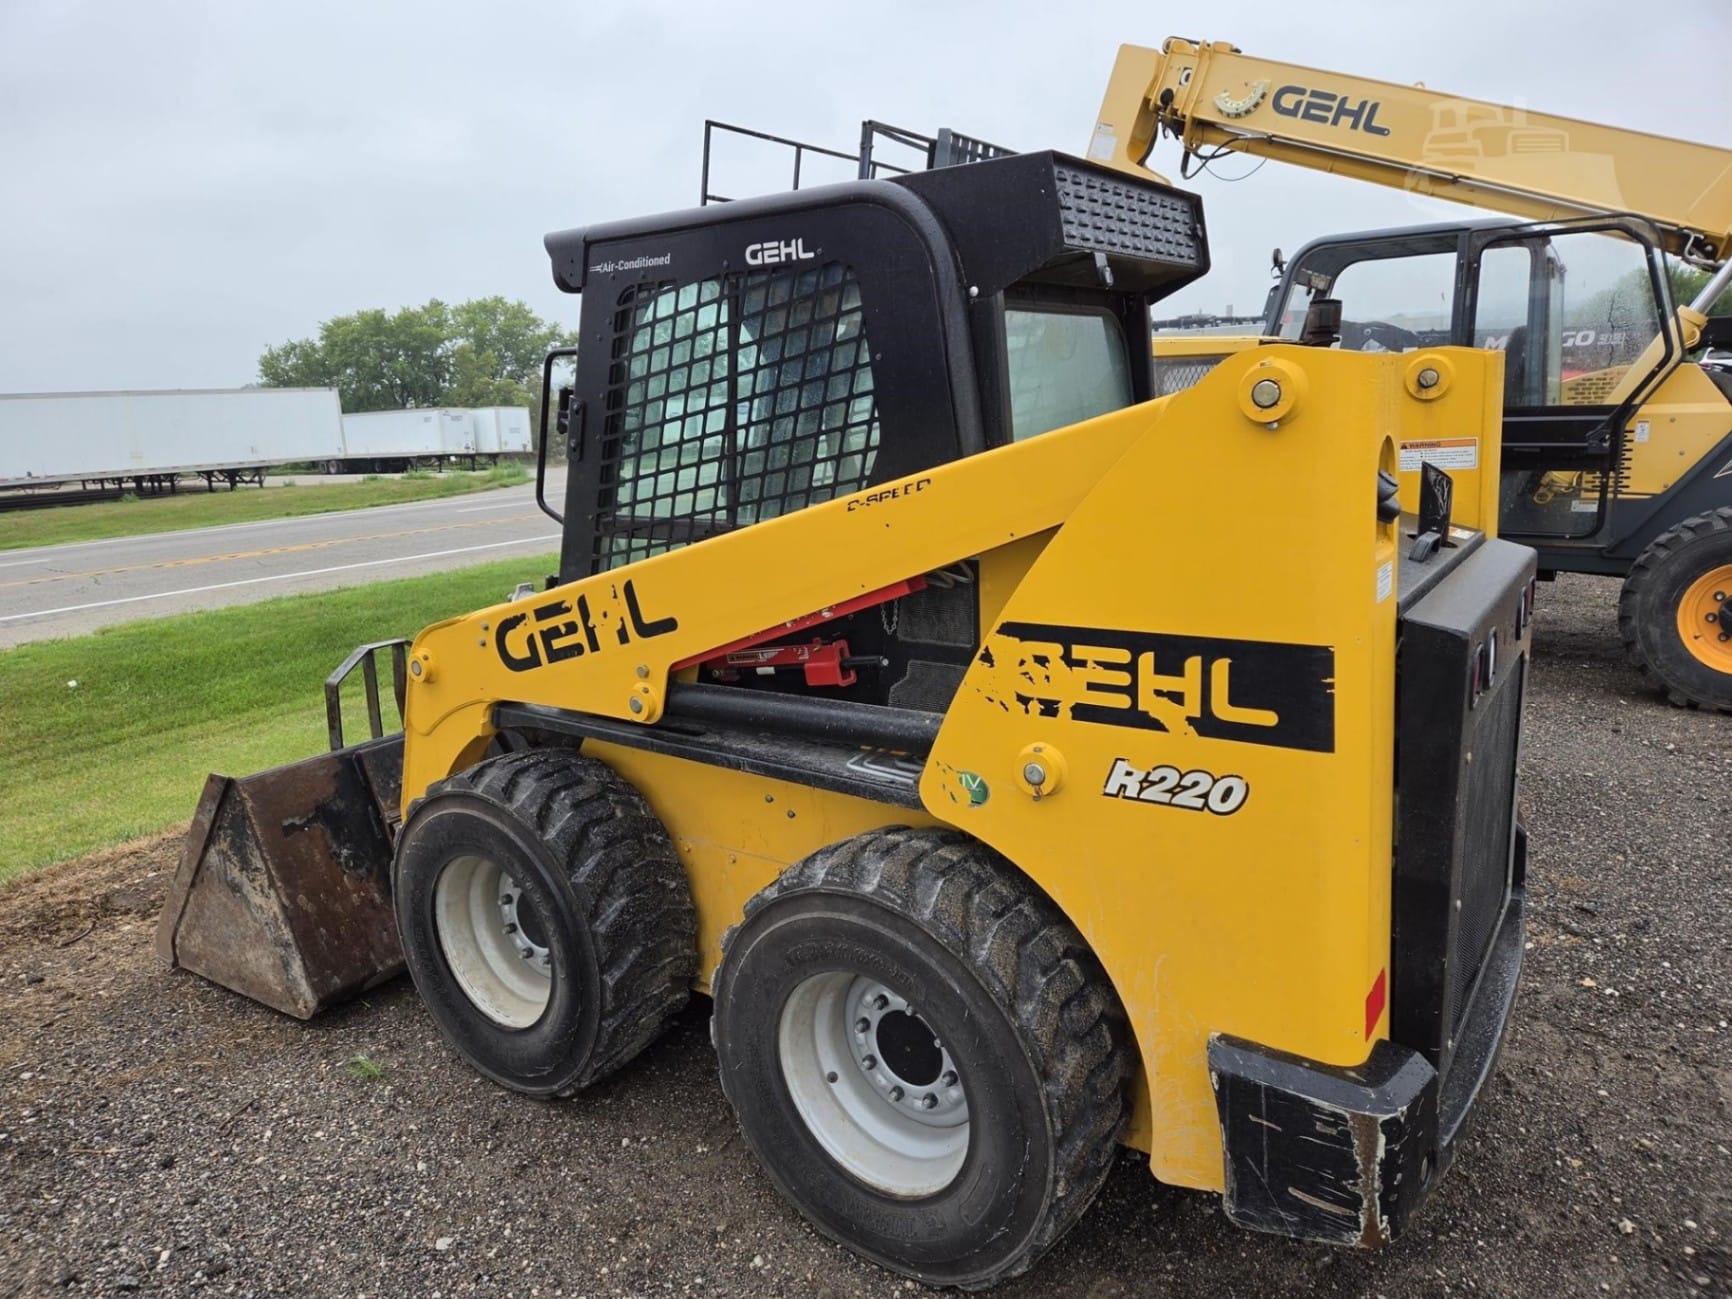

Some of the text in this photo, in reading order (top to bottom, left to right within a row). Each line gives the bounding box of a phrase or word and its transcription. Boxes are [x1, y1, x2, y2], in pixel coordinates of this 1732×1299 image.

[1272, 85, 1390, 136] GEHL
[603, 253, 671, 273] Air-Conditioned
[745, 238, 815, 265] GEHL
[495, 580, 678, 672] GEHL
[1103, 757, 1250, 816] R220
